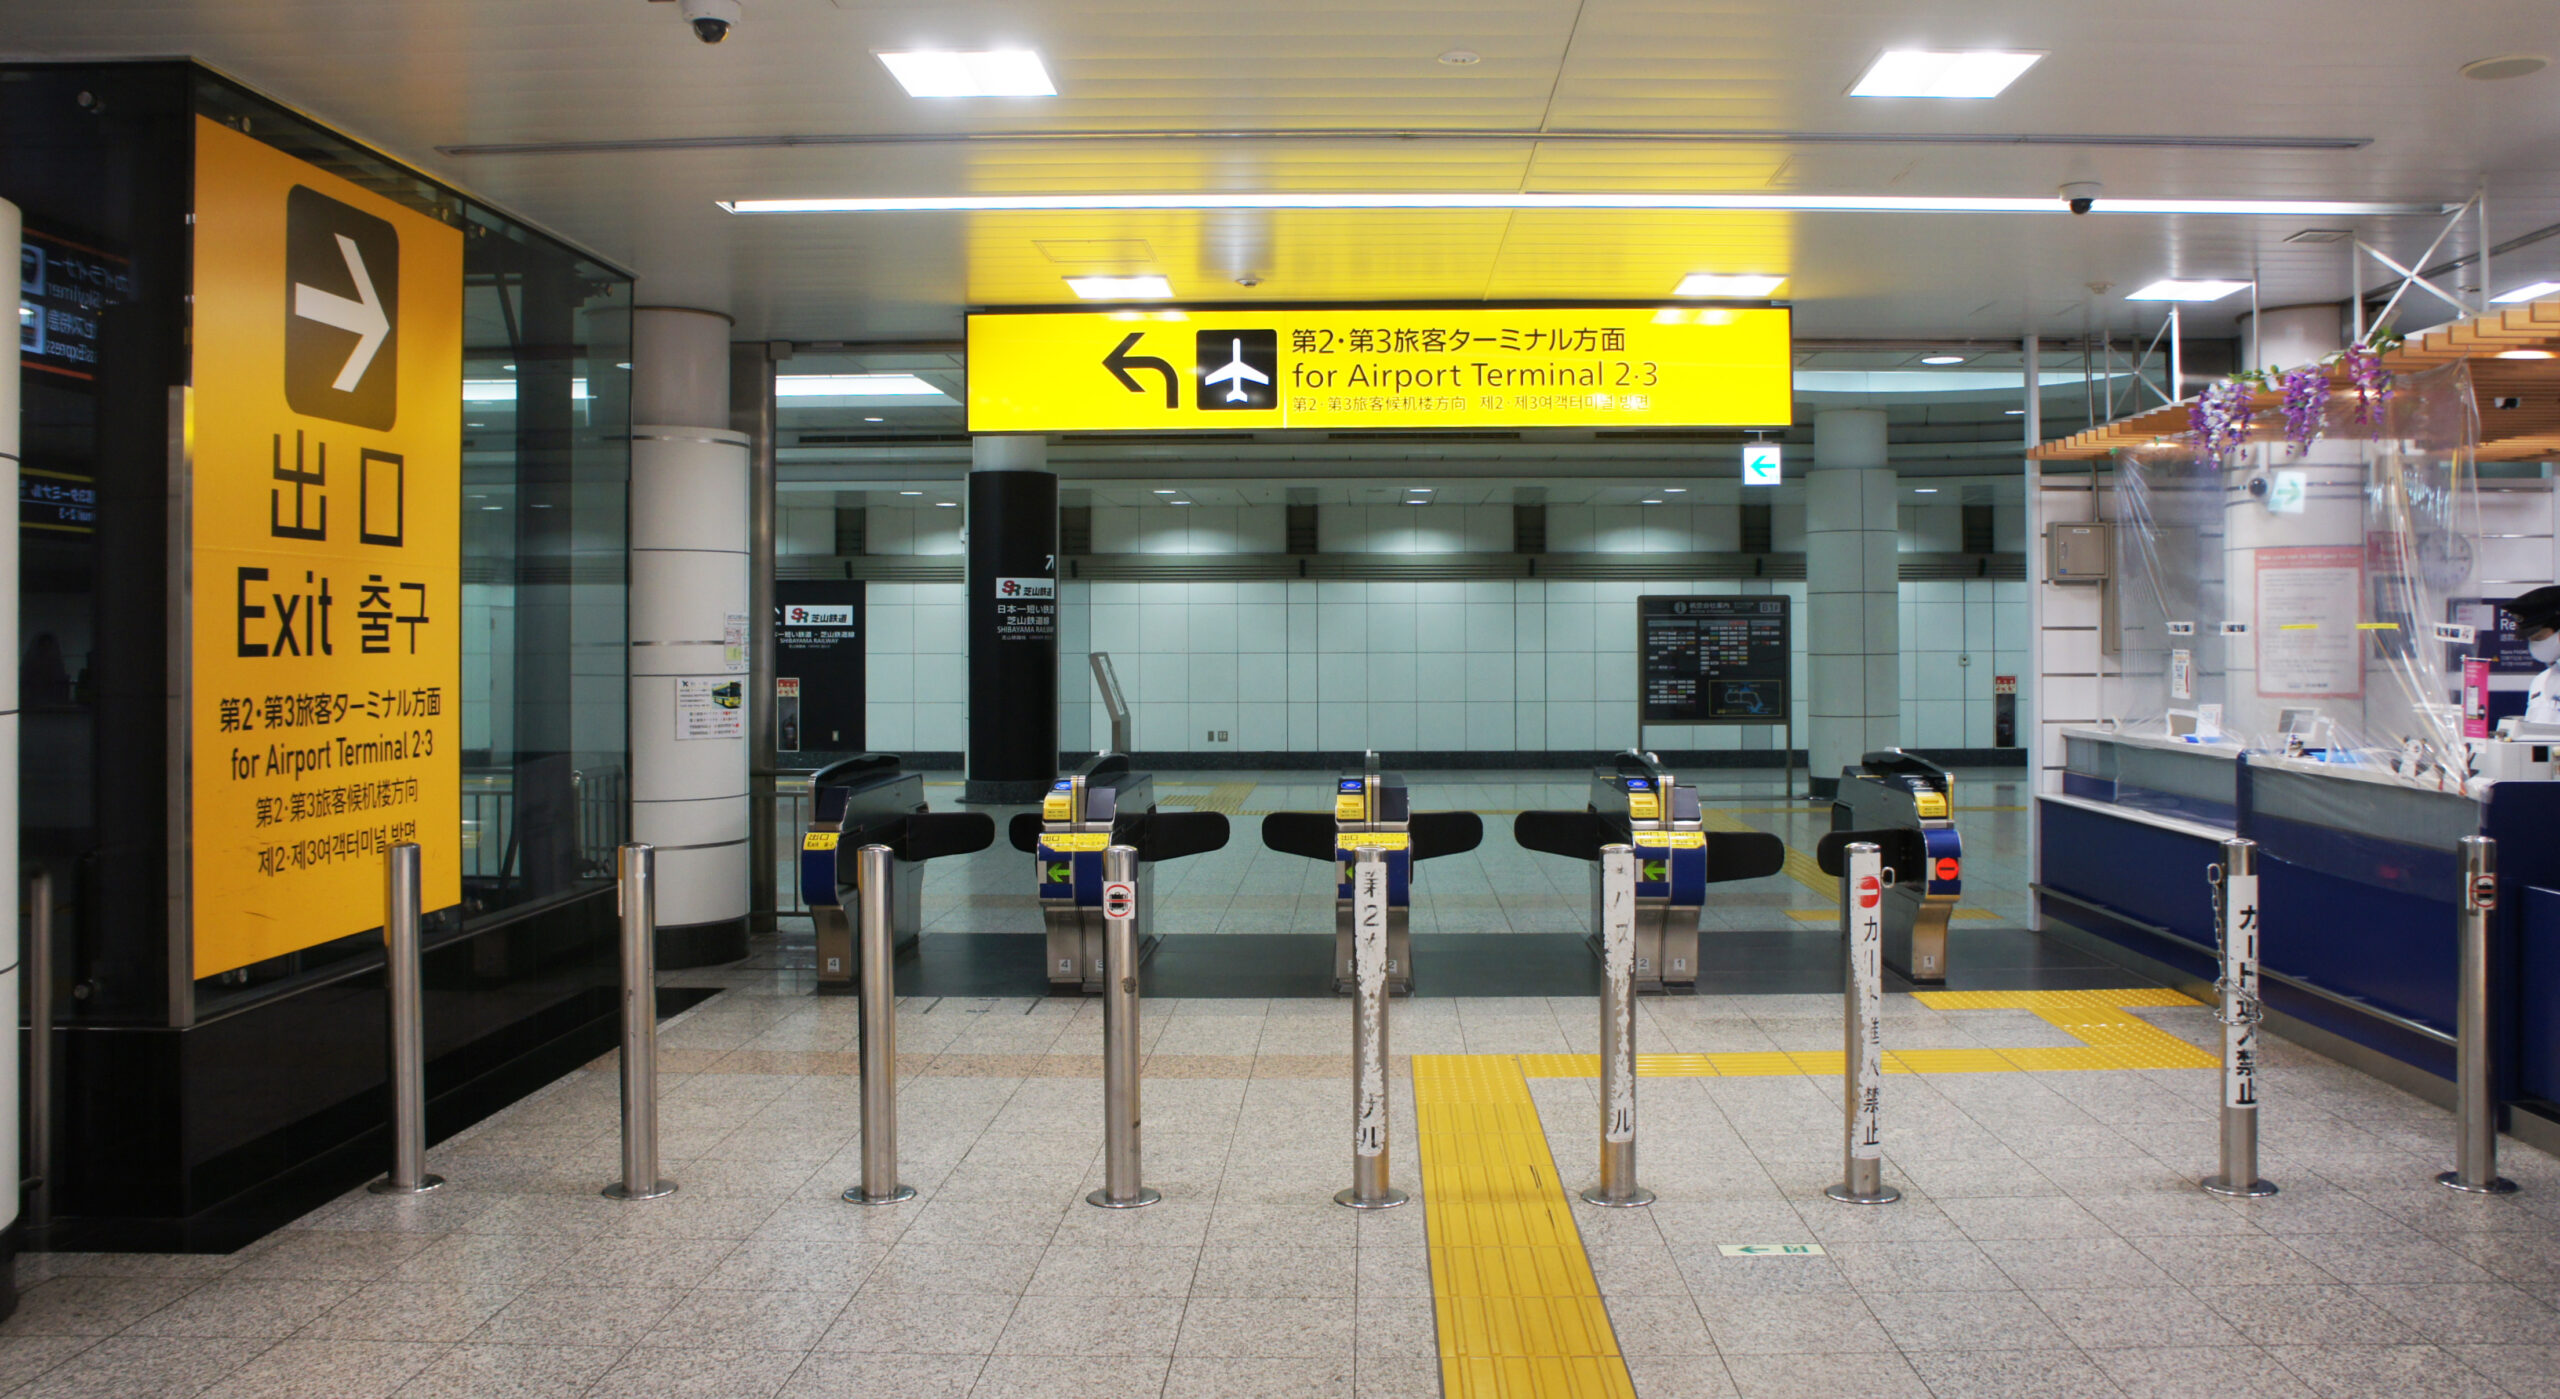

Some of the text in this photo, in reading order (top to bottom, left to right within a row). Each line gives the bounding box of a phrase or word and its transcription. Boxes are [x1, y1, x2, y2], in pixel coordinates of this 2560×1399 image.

[1292, 362, 1338, 388] for
[1347, 363, 1462, 394] Airport
[1470, 360, 1603, 387] Terminal
[271, 429, 404, 548] 出口
[237, 566, 430, 658] Exit 출구
[2500, 618, 2516, 631] Re
[231, 747, 260, 781] for
[265, 740, 332, 782] Airport
[336, 730, 408, 768] Terminal
[829, 959, 837, 968] 4
[1060, 959, 1069, 969] 4
[1640, 958, 1648, 968] 2
